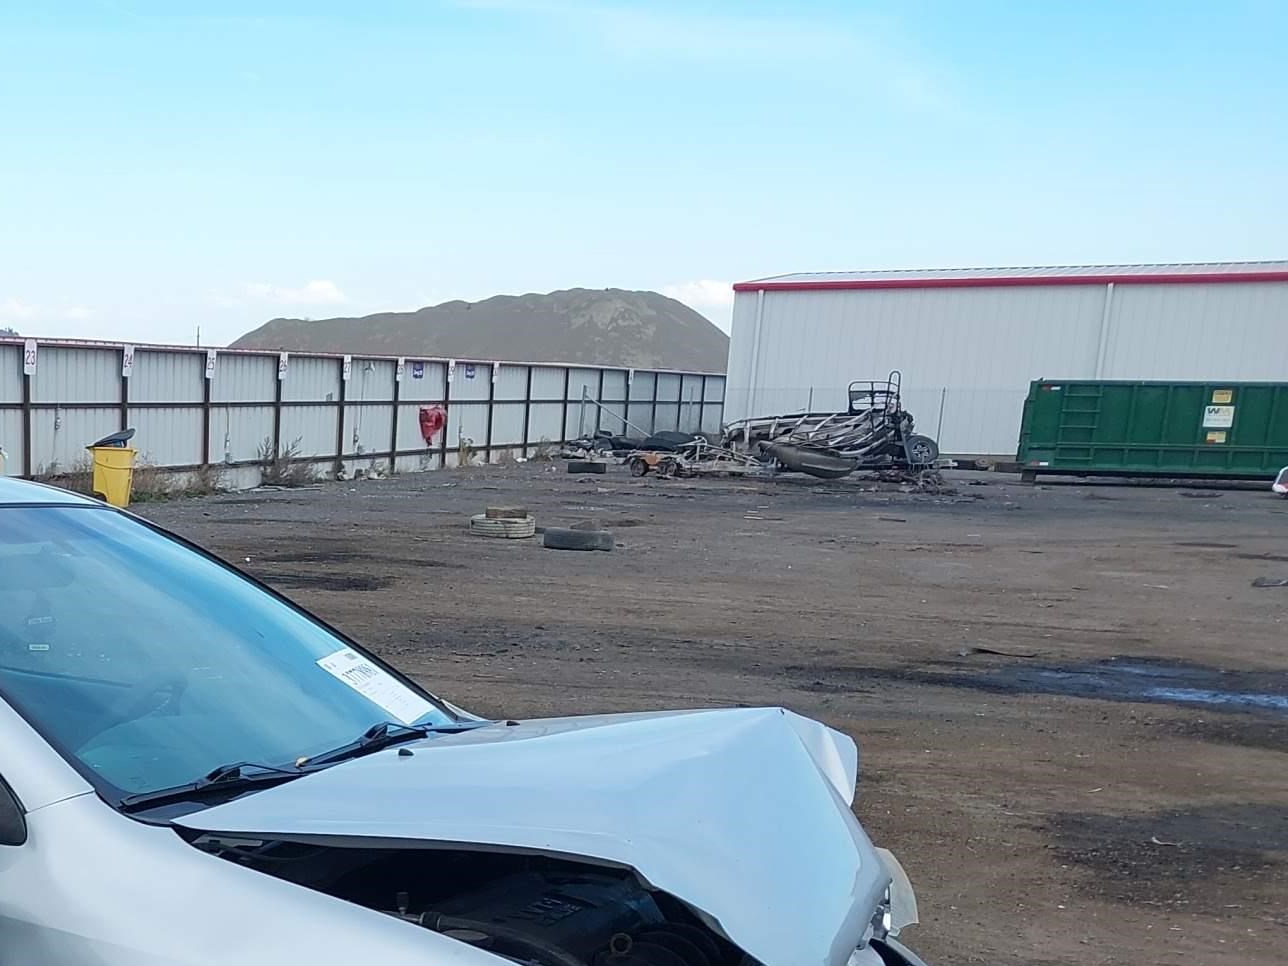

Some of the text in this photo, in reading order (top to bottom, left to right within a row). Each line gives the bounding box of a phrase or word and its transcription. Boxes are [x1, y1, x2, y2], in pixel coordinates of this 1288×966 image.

[25, 350, 36, 365] 23
[124, 354, 132, 368] 24
[208, 356, 215, 370] 25
